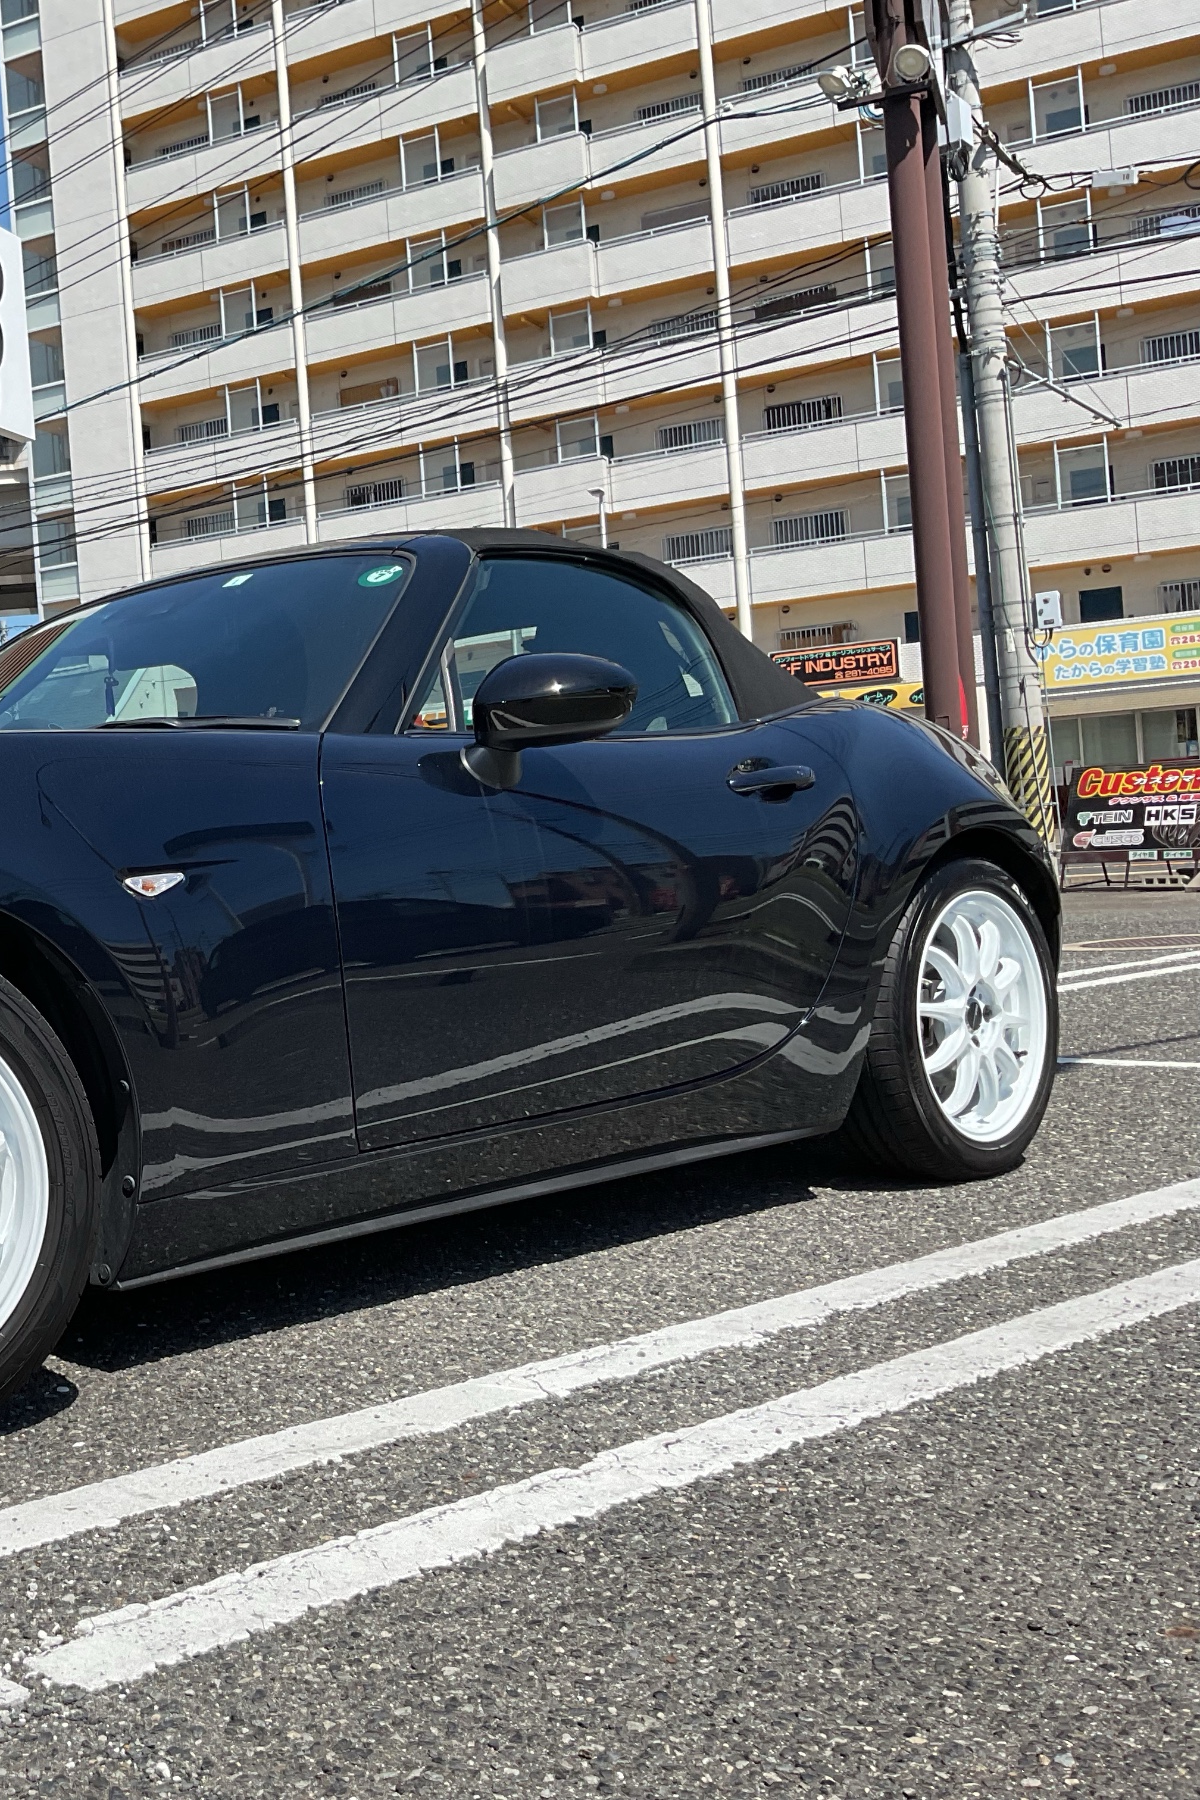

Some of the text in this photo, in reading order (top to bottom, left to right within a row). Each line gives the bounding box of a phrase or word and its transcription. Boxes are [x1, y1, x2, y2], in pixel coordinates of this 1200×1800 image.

[805, 652, 891, 673] INDUSTRY
[1054, 656, 1166, 680] たからの学習塾
[1134, 774, 1200, 786] カスタマ
[1091, 805, 1196, 825] TEIN HKS
[1091, 833, 1144, 846] CUSCO
